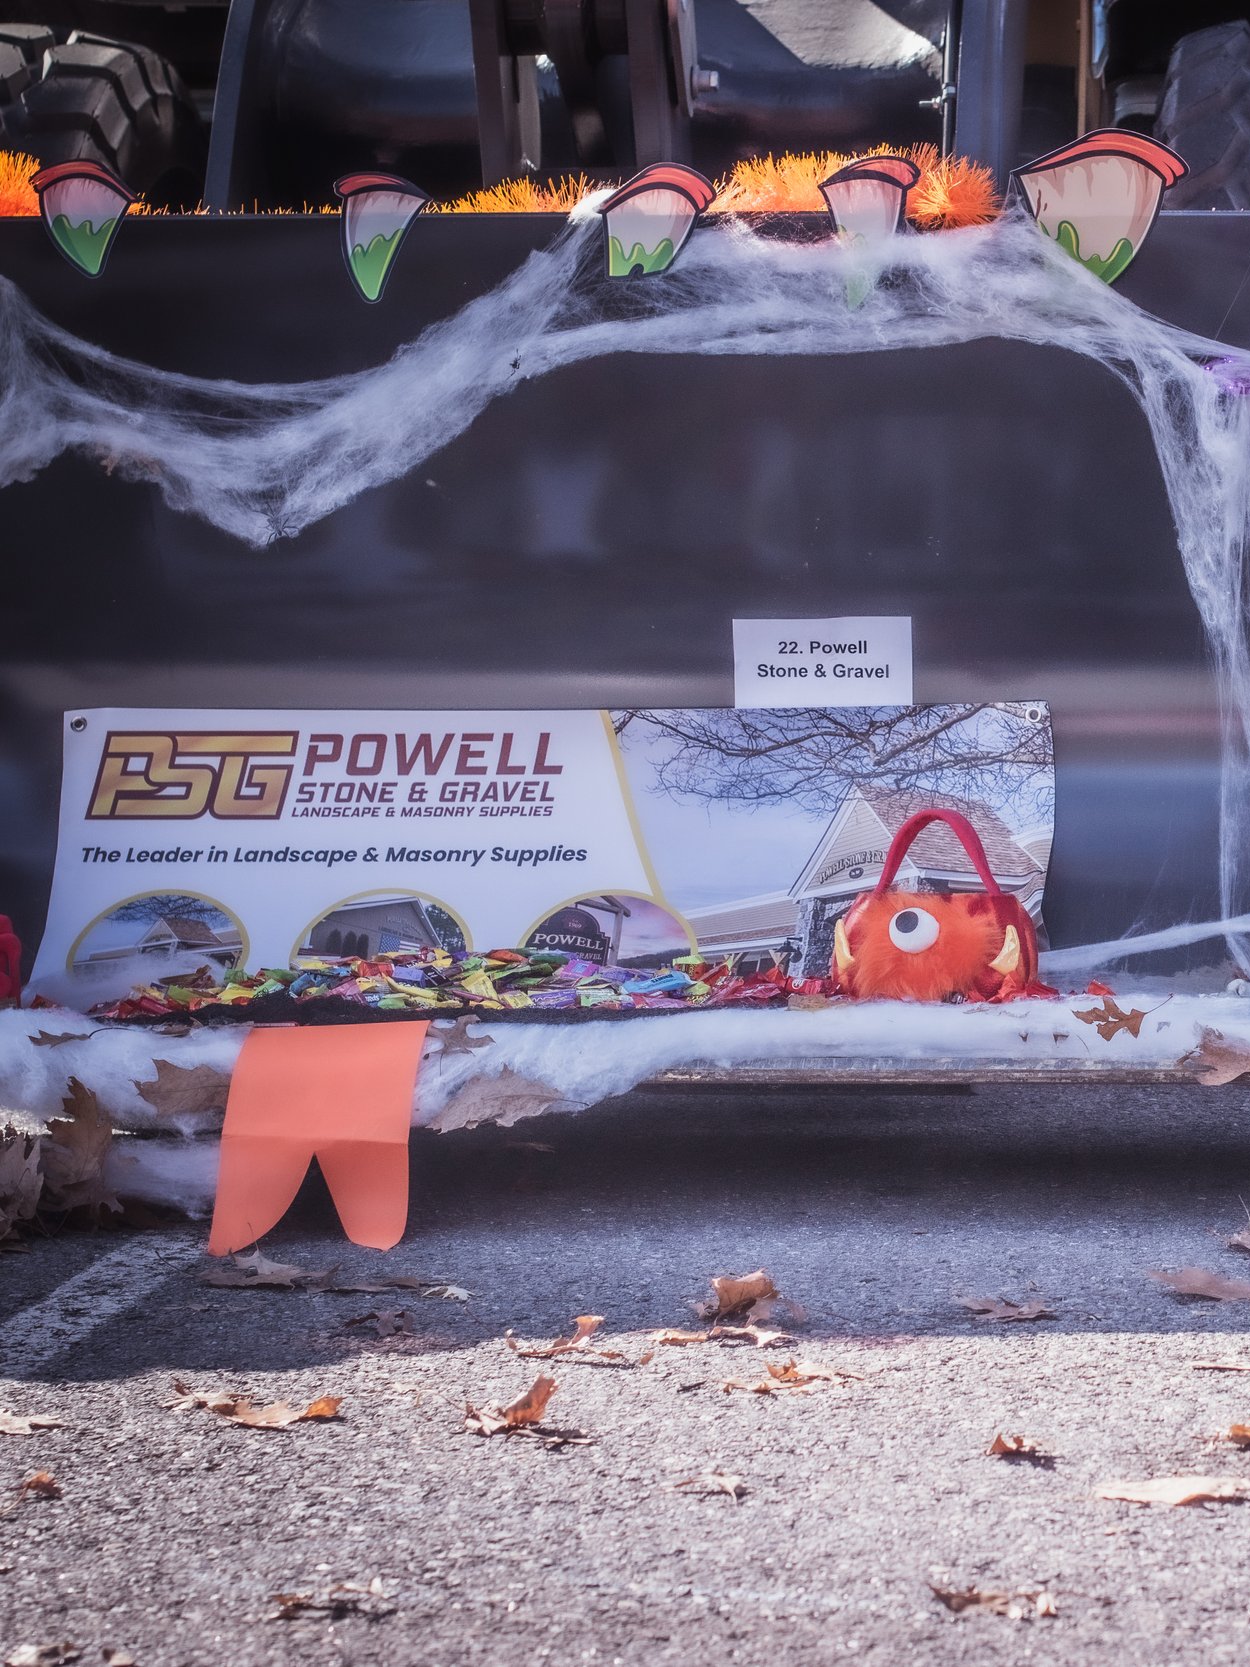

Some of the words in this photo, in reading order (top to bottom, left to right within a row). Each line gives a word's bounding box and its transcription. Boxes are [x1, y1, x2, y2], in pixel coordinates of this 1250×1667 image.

[778, 641, 803, 654] 22.
[809, 640, 867, 654] Powell
[757, 664, 808, 678] Stone
[814, 663, 827, 678] &
[833, 664, 889, 678] Gravel
[302, 732, 564, 776] POWELL
[84, 731, 300, 820] PSG
[295, 782, 399, 803] STONE
[407, 782, 429, 803] &
[438, 781, 555, 803] GRAVEL
[291, 807, 381, 818] LANDSCAPE
[385, 807, 396, 818] &
[400, 806, 475, 818] MASONRY
[478, 806, 554, 817] SUPPLIES
[82, 846, 122, 863] The
[125, 846, 204, 863] Leader
[207, 845, 229, 863] in
[233, 846, 358, 868] Landscape
[362, 847, 379, 862] &
[385, 846, 487, 867] Masonry
[490, 844, 588, 867] Supplies
[533, 933, 604, 951] POWELL
